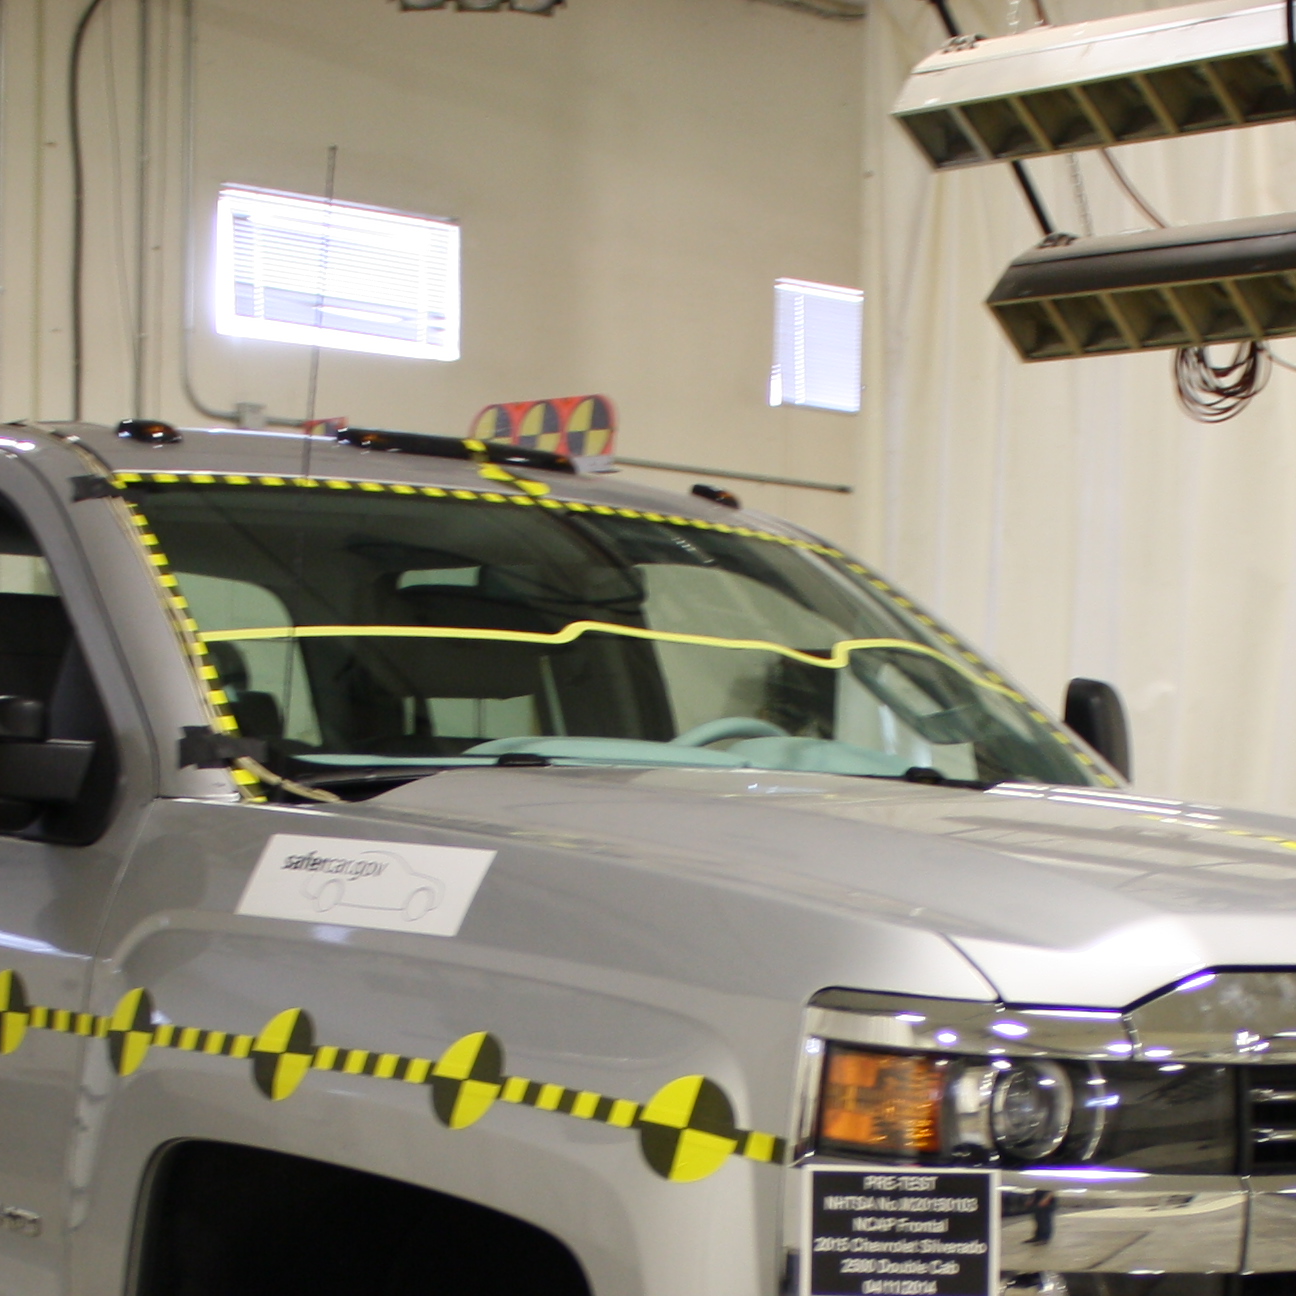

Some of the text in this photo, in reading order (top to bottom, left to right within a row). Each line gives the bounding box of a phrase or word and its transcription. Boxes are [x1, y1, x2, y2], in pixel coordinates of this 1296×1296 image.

[281, 850, 389, 881] safercar.gov
[863, 1175, 939, 1191] PRE-TEST
[823, 1196, 878, 1211] NHTSA
[852, 1216, 949, 1233] NCAP Frontal
[813, 1237, 987, 1254] 2015 Chevrolet Silverado
[876, 1258, 928, 1274] Double
[929, 1260, 960, 1275] Cab
